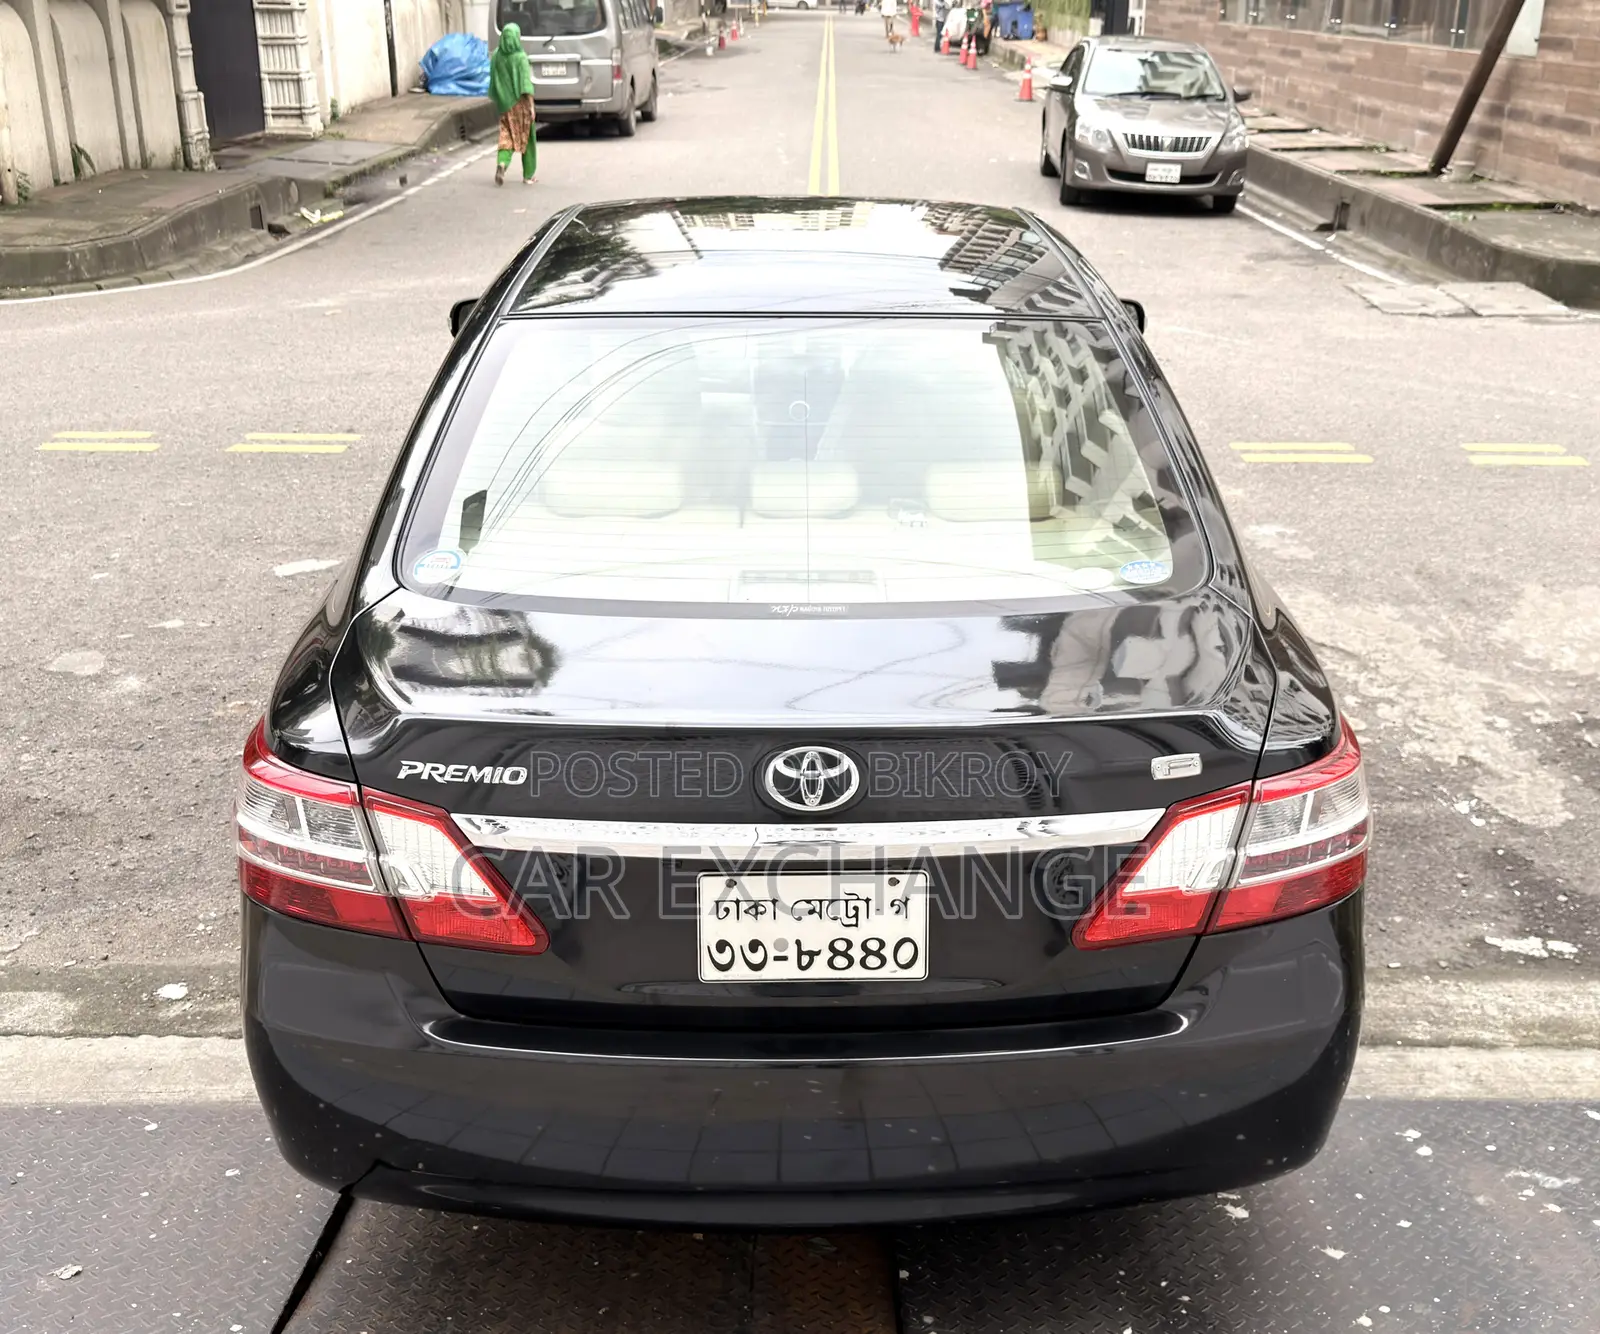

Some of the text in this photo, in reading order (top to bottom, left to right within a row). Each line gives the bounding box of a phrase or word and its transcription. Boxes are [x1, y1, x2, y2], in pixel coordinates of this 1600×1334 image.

[396, 760, 528, 786] PREMIO
[713, 897, 779, 922] ঢাকা
[706, 936, 920, 973] ৩৩-৮৪৪০
